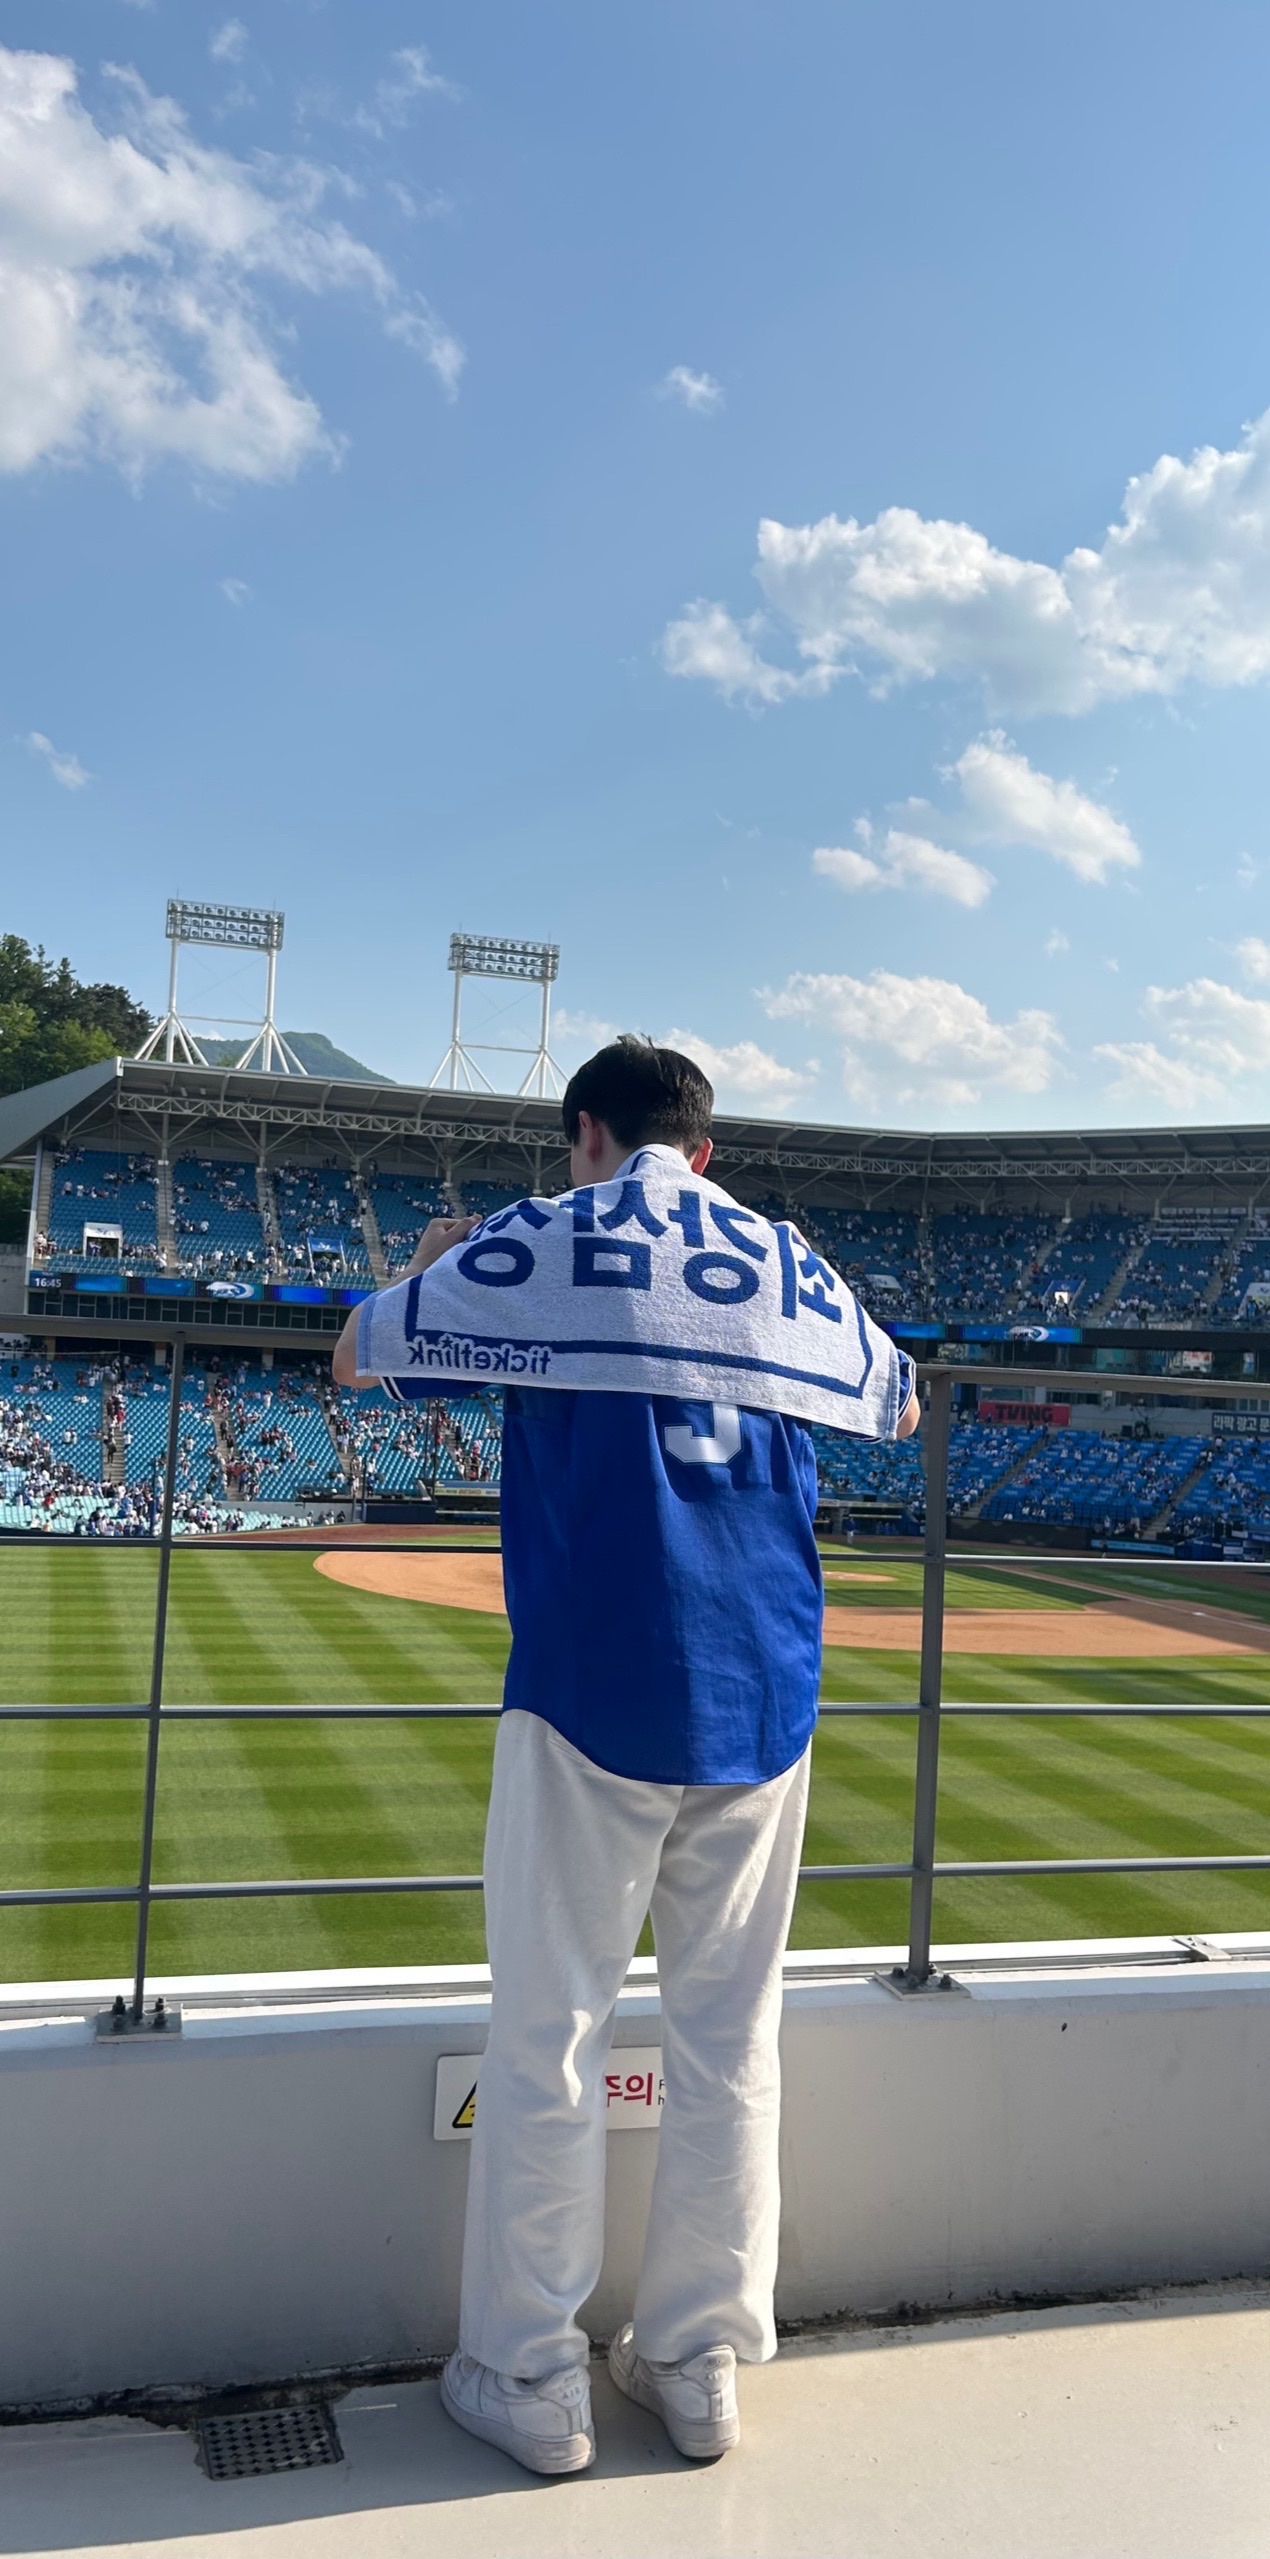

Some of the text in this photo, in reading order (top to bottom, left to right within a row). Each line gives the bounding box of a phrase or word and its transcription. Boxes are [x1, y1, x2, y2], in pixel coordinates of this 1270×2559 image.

[35, 1278, 62, 1288] 16:45
[995, 1404, 1053, 1421] TVING
[605, 2072, 653, 2107] 주의
